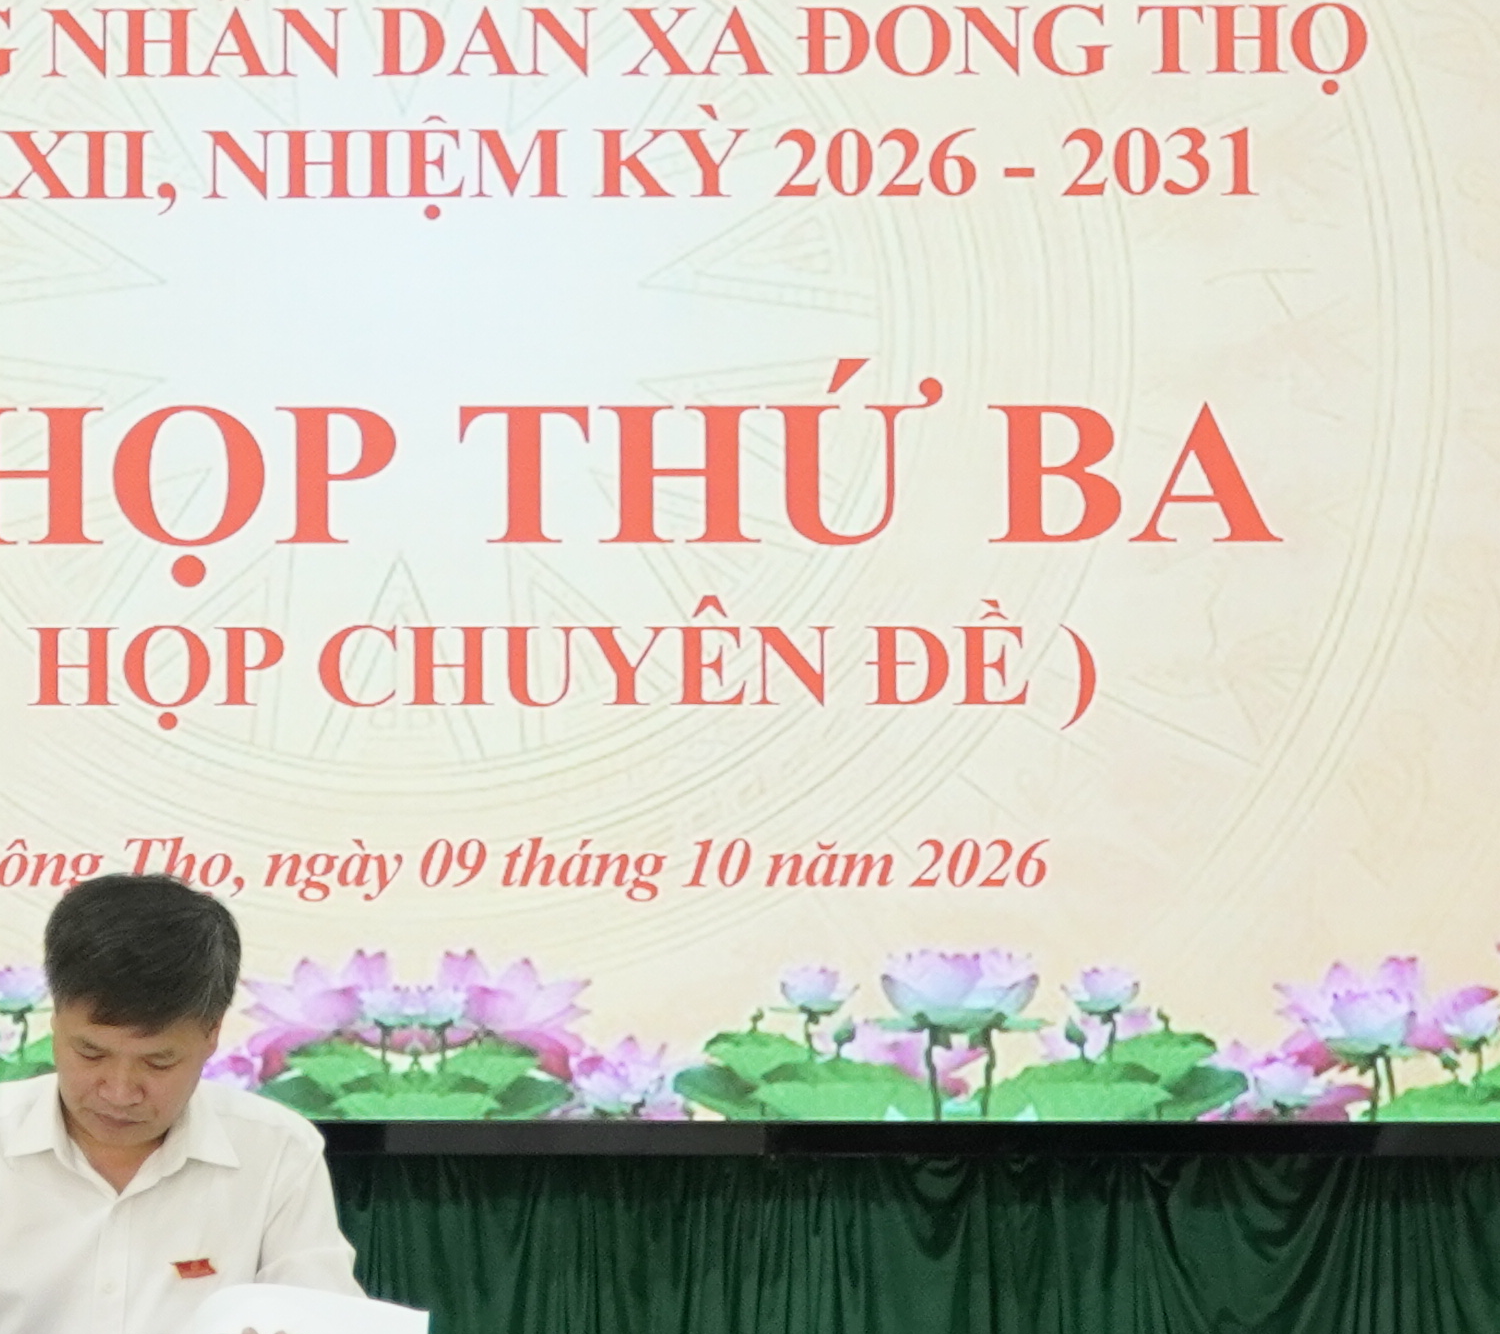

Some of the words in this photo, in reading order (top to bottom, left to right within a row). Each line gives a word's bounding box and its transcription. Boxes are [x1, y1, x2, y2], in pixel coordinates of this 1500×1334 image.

[1136, 0, 1370, 97] THỌ
[202, 115, 566, 221] NHIỆM
[594, 103, 748, 199] KỲ
[774, 127, 980, 198] 2026
[1002, 166, 1037, 180] -
[1060, 126, 1257, 197] 2031
[459, 355, 944, 548] THỨ
[986, 399, 1284, 545] BA
[30, 623, 286, 732] HỌP
[317, 593, 830, 709] CHUYÊN
[263, 838, 404, 902] ngày
[418, 838, 489, 888] 09
[500, 836, 668, 903] tháng
[681, 837, 753, 888] 10
[764, 840, 896, 888] năm
[908, 837, 1051, 889] 2026
